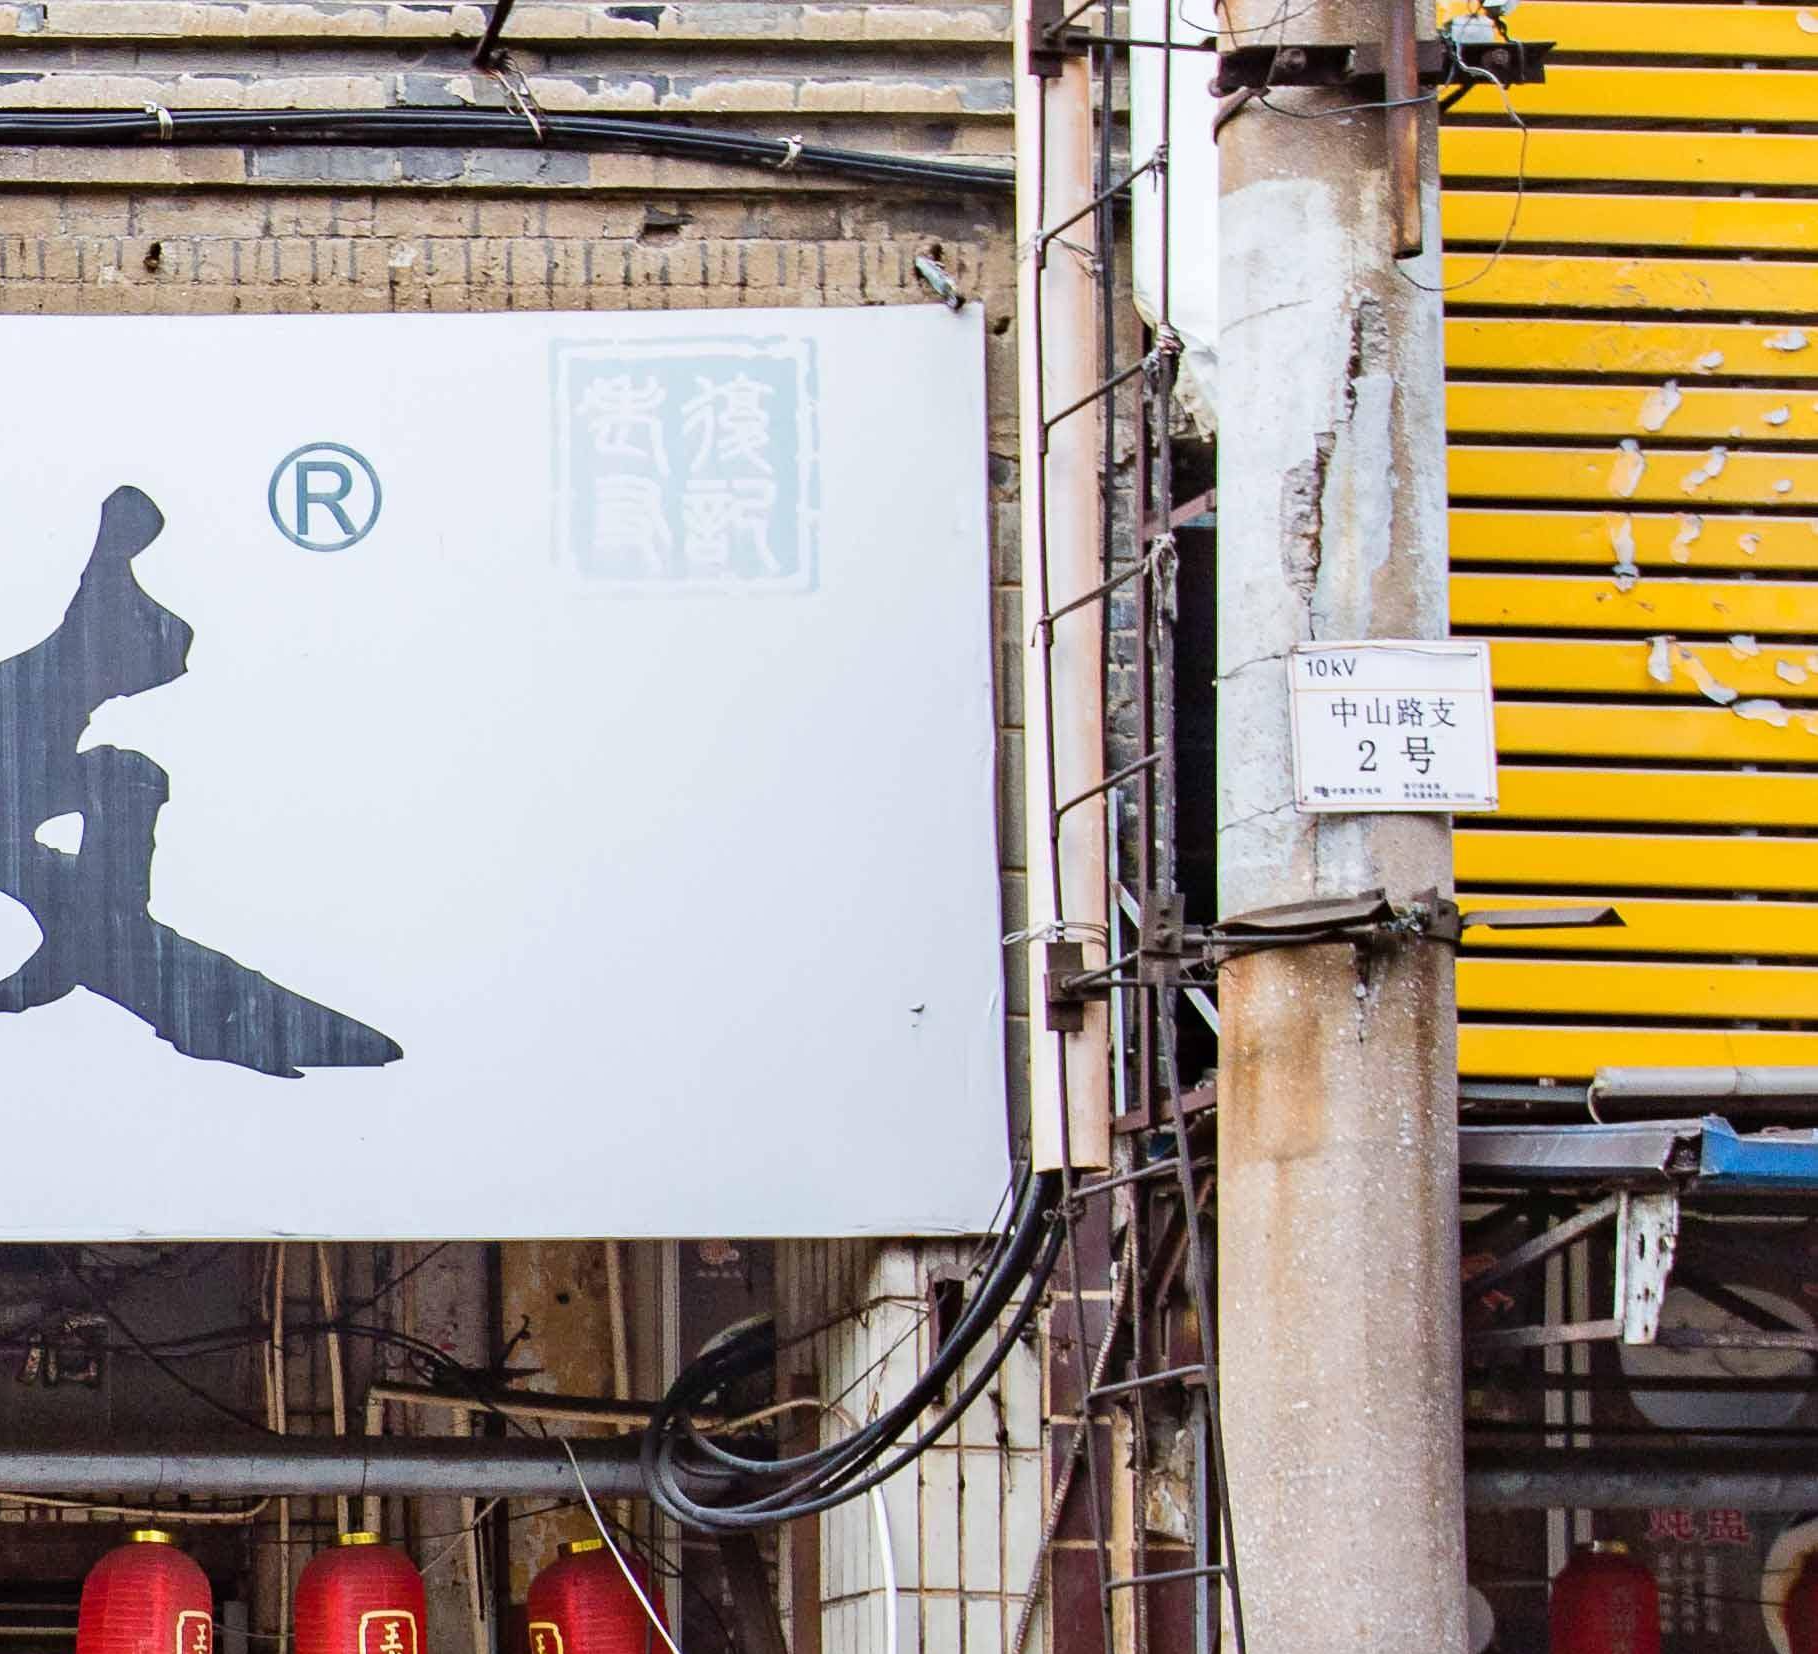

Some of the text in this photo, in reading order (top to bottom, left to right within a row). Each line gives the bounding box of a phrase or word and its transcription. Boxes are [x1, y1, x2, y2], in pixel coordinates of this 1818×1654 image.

[1305, 657, 1357, 678] 10kV
[1331, 696, 1457, 729] 中山路支
